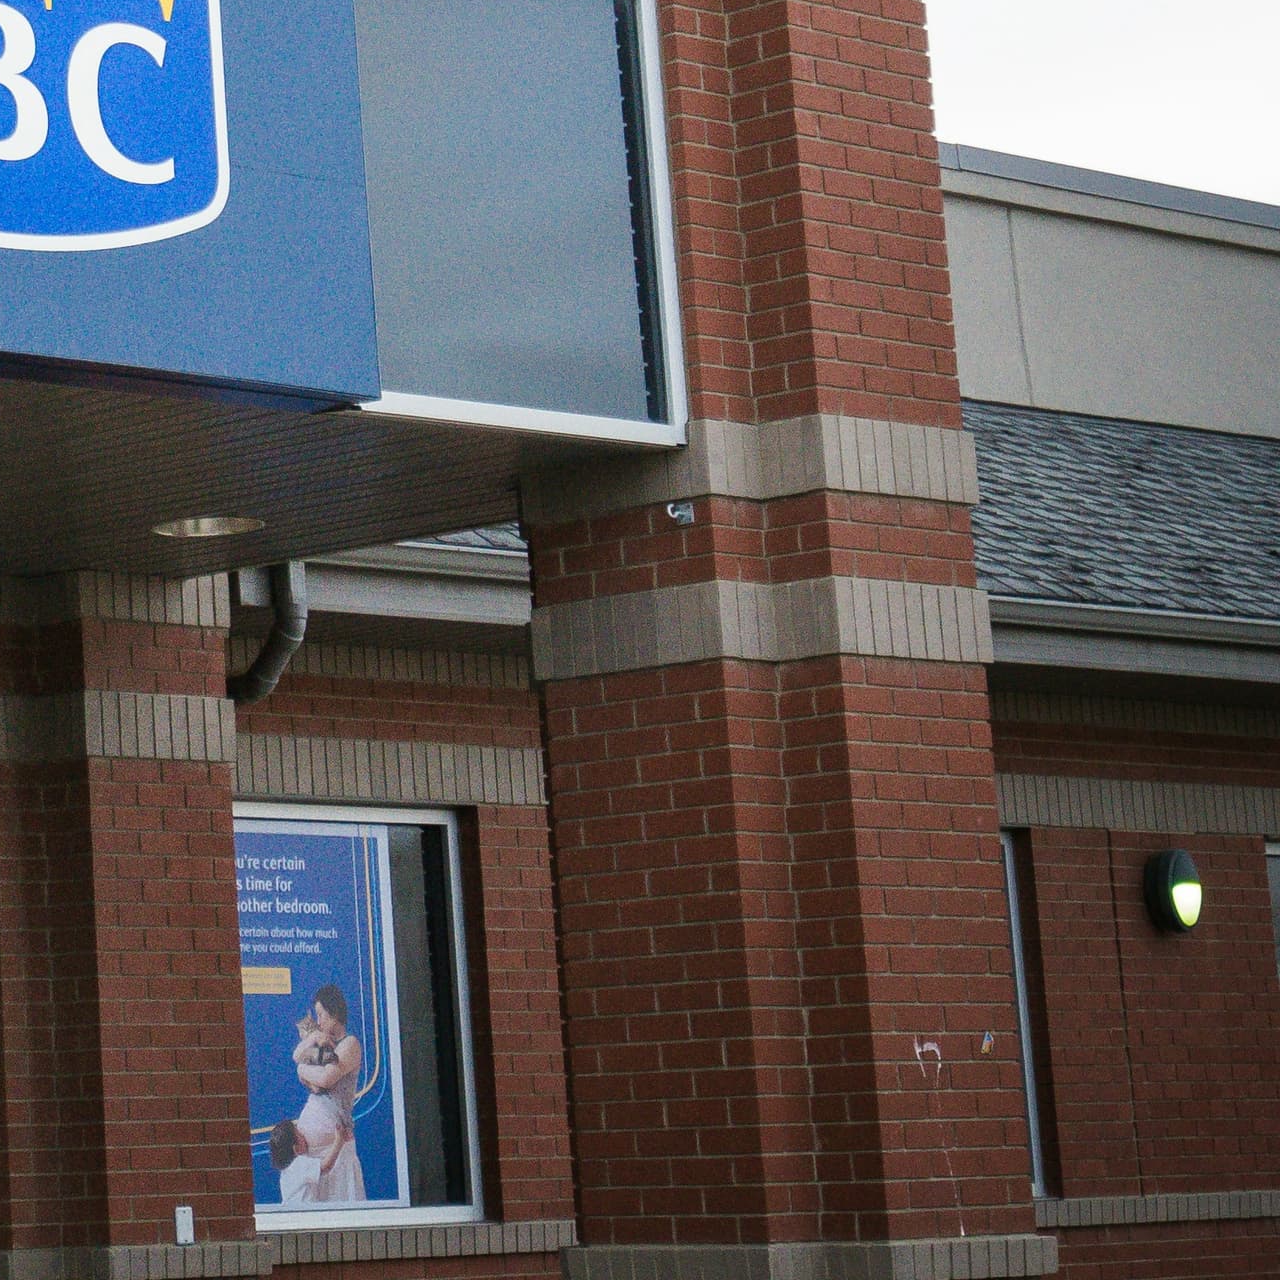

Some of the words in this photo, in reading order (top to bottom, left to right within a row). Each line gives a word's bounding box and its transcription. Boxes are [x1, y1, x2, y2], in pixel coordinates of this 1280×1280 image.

[235, 855, 260, 869] u're
[263, 855, 306, 870] certain
[246, 876, 273, 891] time
[276, 876, 293, 892] for
[276, 898, 333, 915] bedroom.
[270, 926, 295, 938] about
[296, 926, 313, 938] how
[314, 927, 338, 939] much
[252, 943, 268, 955] you
[269, 942, 293, 953] could
